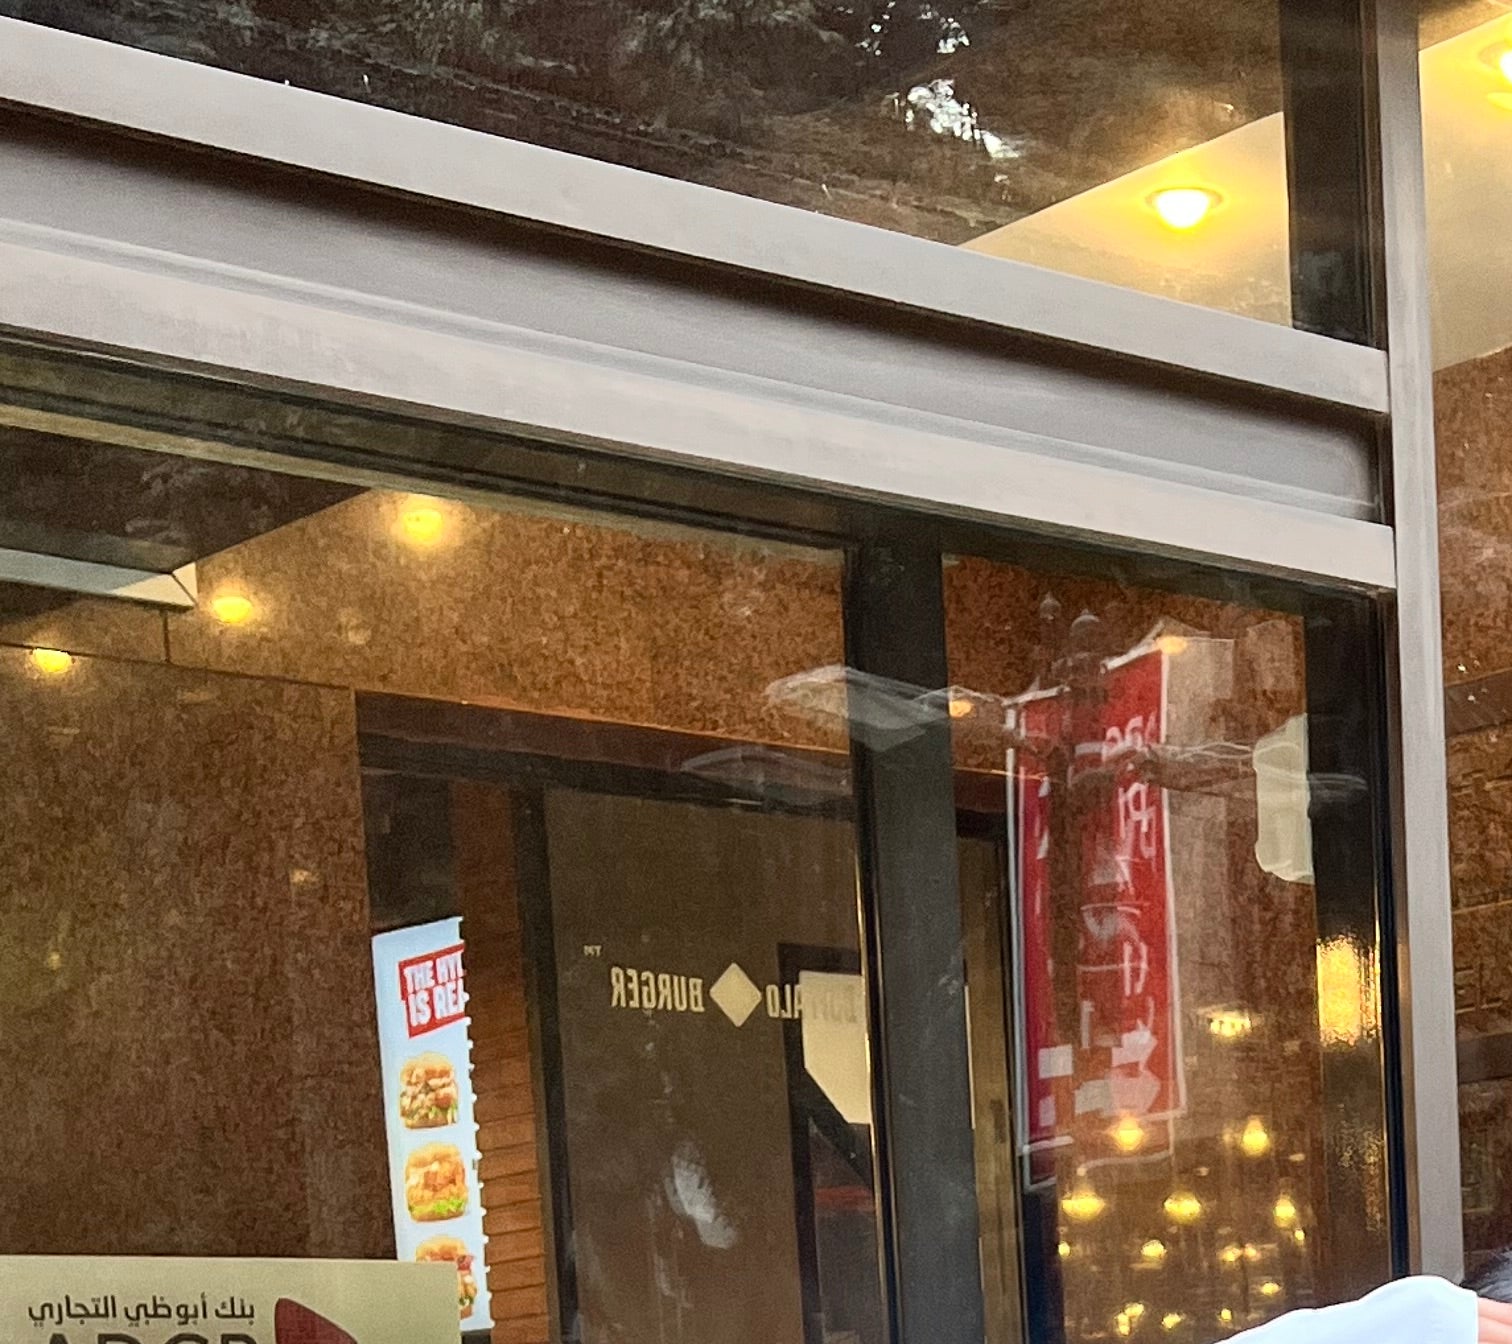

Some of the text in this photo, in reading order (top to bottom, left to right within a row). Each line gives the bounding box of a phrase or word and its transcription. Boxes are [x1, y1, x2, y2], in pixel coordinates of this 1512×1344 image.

[404, 960, 435, 994] THE
[408, 990, 431, 1027] IS
[28, 1294, 117, 1329] التجاري
[214, 1296, 256, 1327] بنك
